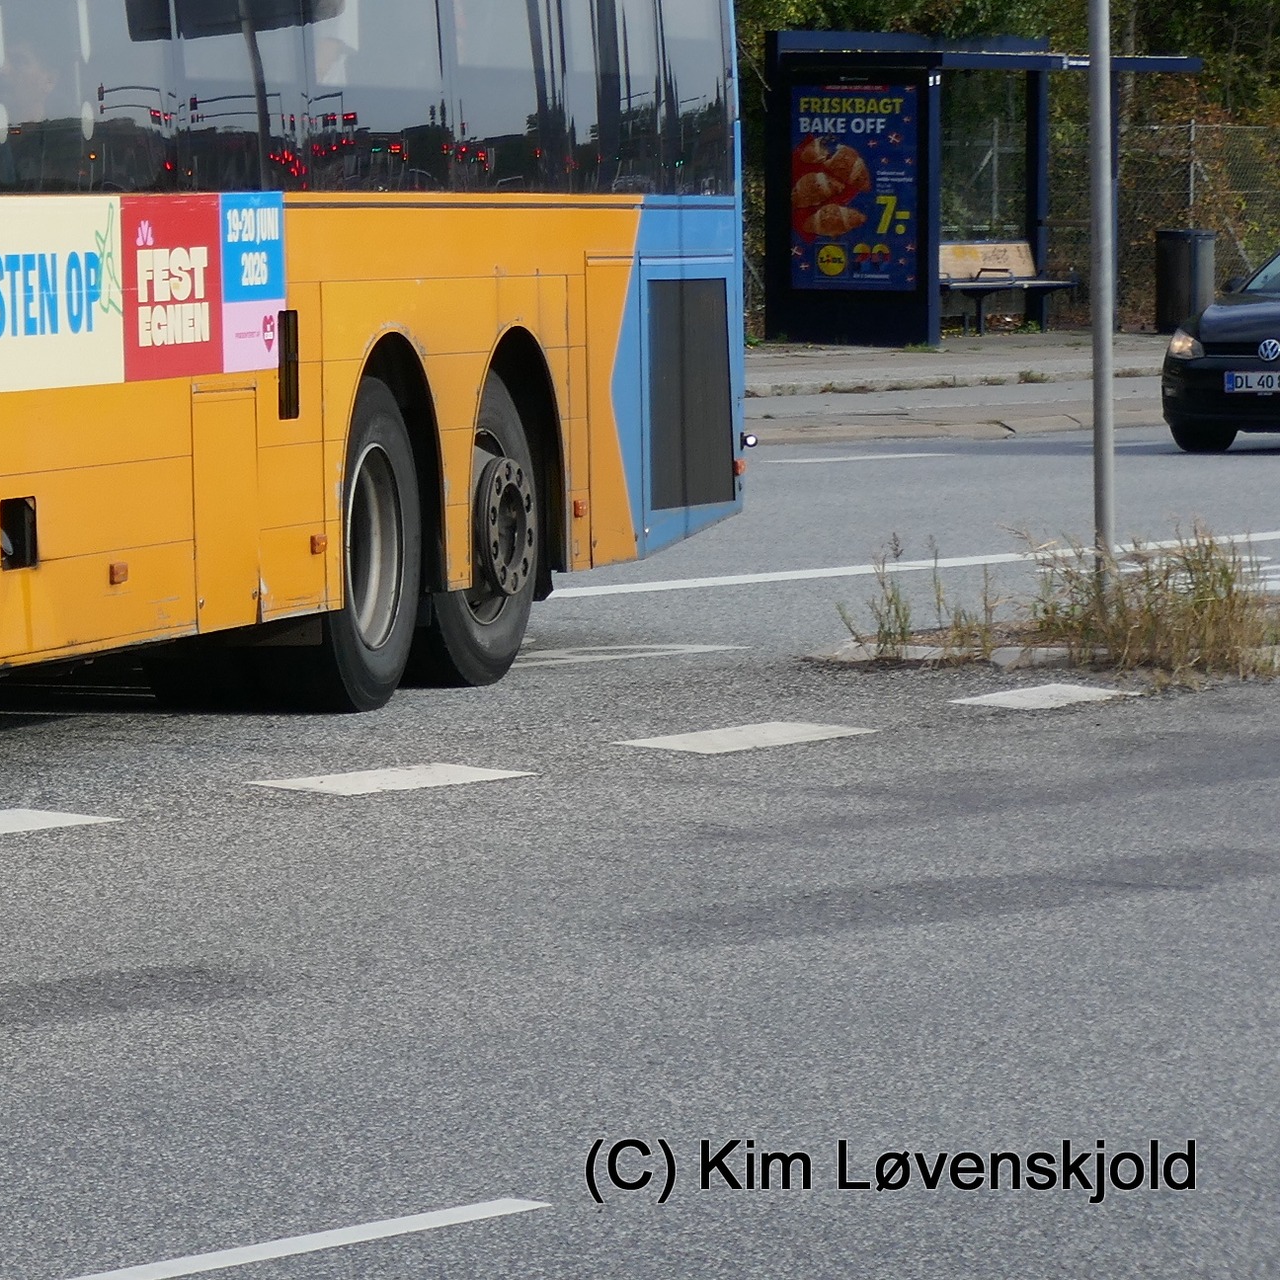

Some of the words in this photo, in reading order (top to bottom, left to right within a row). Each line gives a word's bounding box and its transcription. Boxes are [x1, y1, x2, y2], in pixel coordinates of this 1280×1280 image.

[799, 97, 904, 114] FRISKBAGT
[799, 117, 847, 133] BAKE
[851, 117, 887, 133] OFF
[227, 208, 255, 243] 19-20
[256, 207, 279, 245] JUNI
[136, 246, 208, 303] FEST
[241, 251, 268, 286] 2026
[66, 250, 101, 335] OP
[138, 302, 210, 347] EGNEN
[1235, 375, 1253, 389] DL
[1257, 374, 1274, 389] 40
